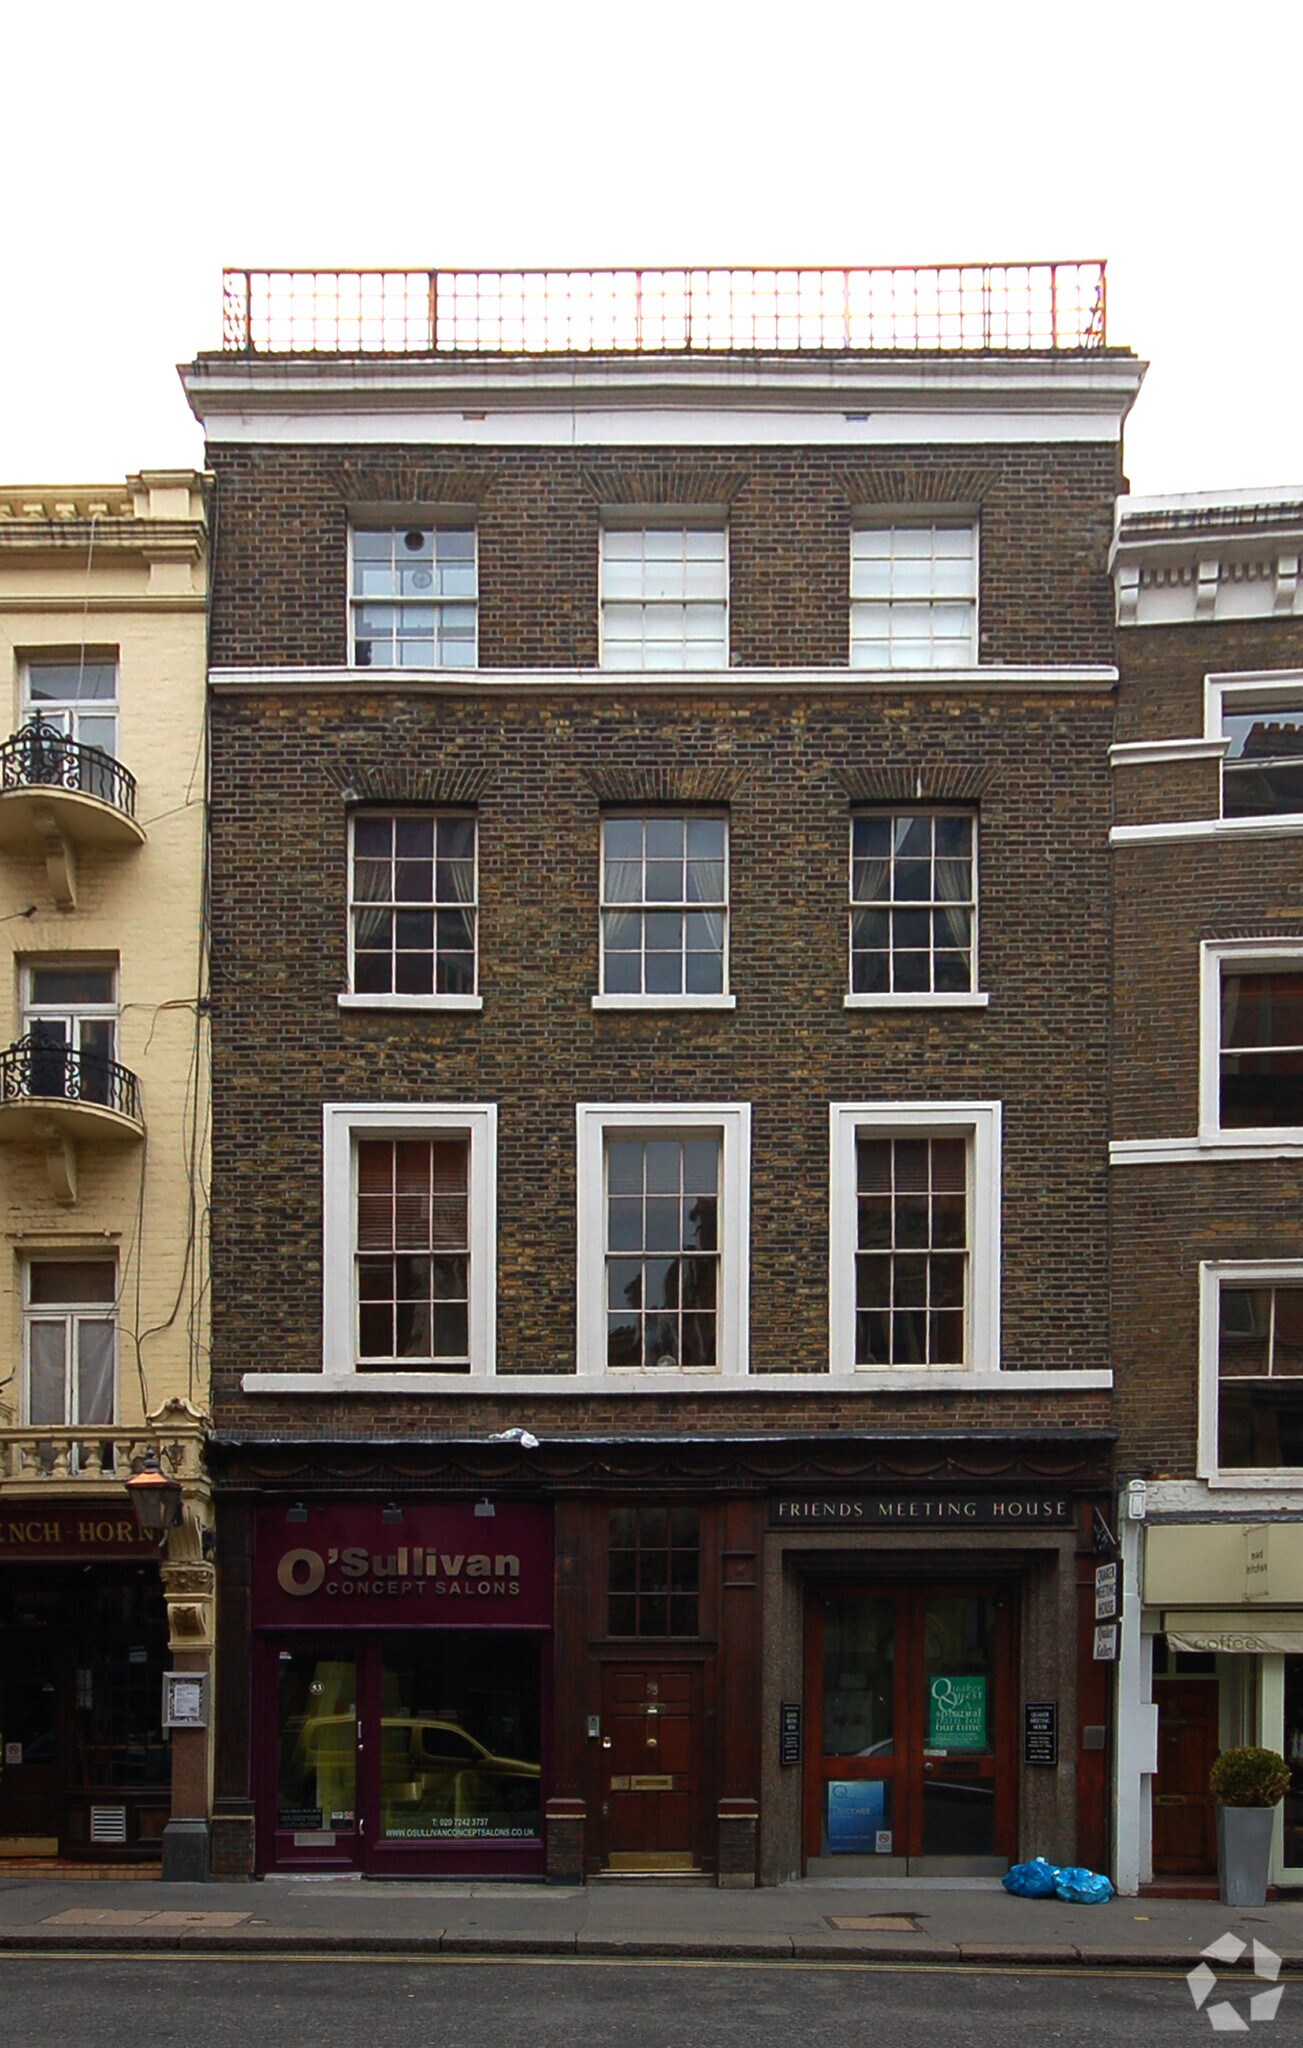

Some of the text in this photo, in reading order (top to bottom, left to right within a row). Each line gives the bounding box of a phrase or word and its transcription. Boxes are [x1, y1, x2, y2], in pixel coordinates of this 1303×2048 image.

[778, 1501, 1067, 1517] FRIENDS MEETING HOUSE
[79, 1522, 154, 1542] HORN
[277, 1547, 520, 1597] O'Sullivan
[326, 1581, 520, 1595] CONCEPT SALONS
[1194, 1634, 1258, 1651] coffee
[439, 1818, 452, 1827] 020
[454, 1818, 471, 1827] 7242
